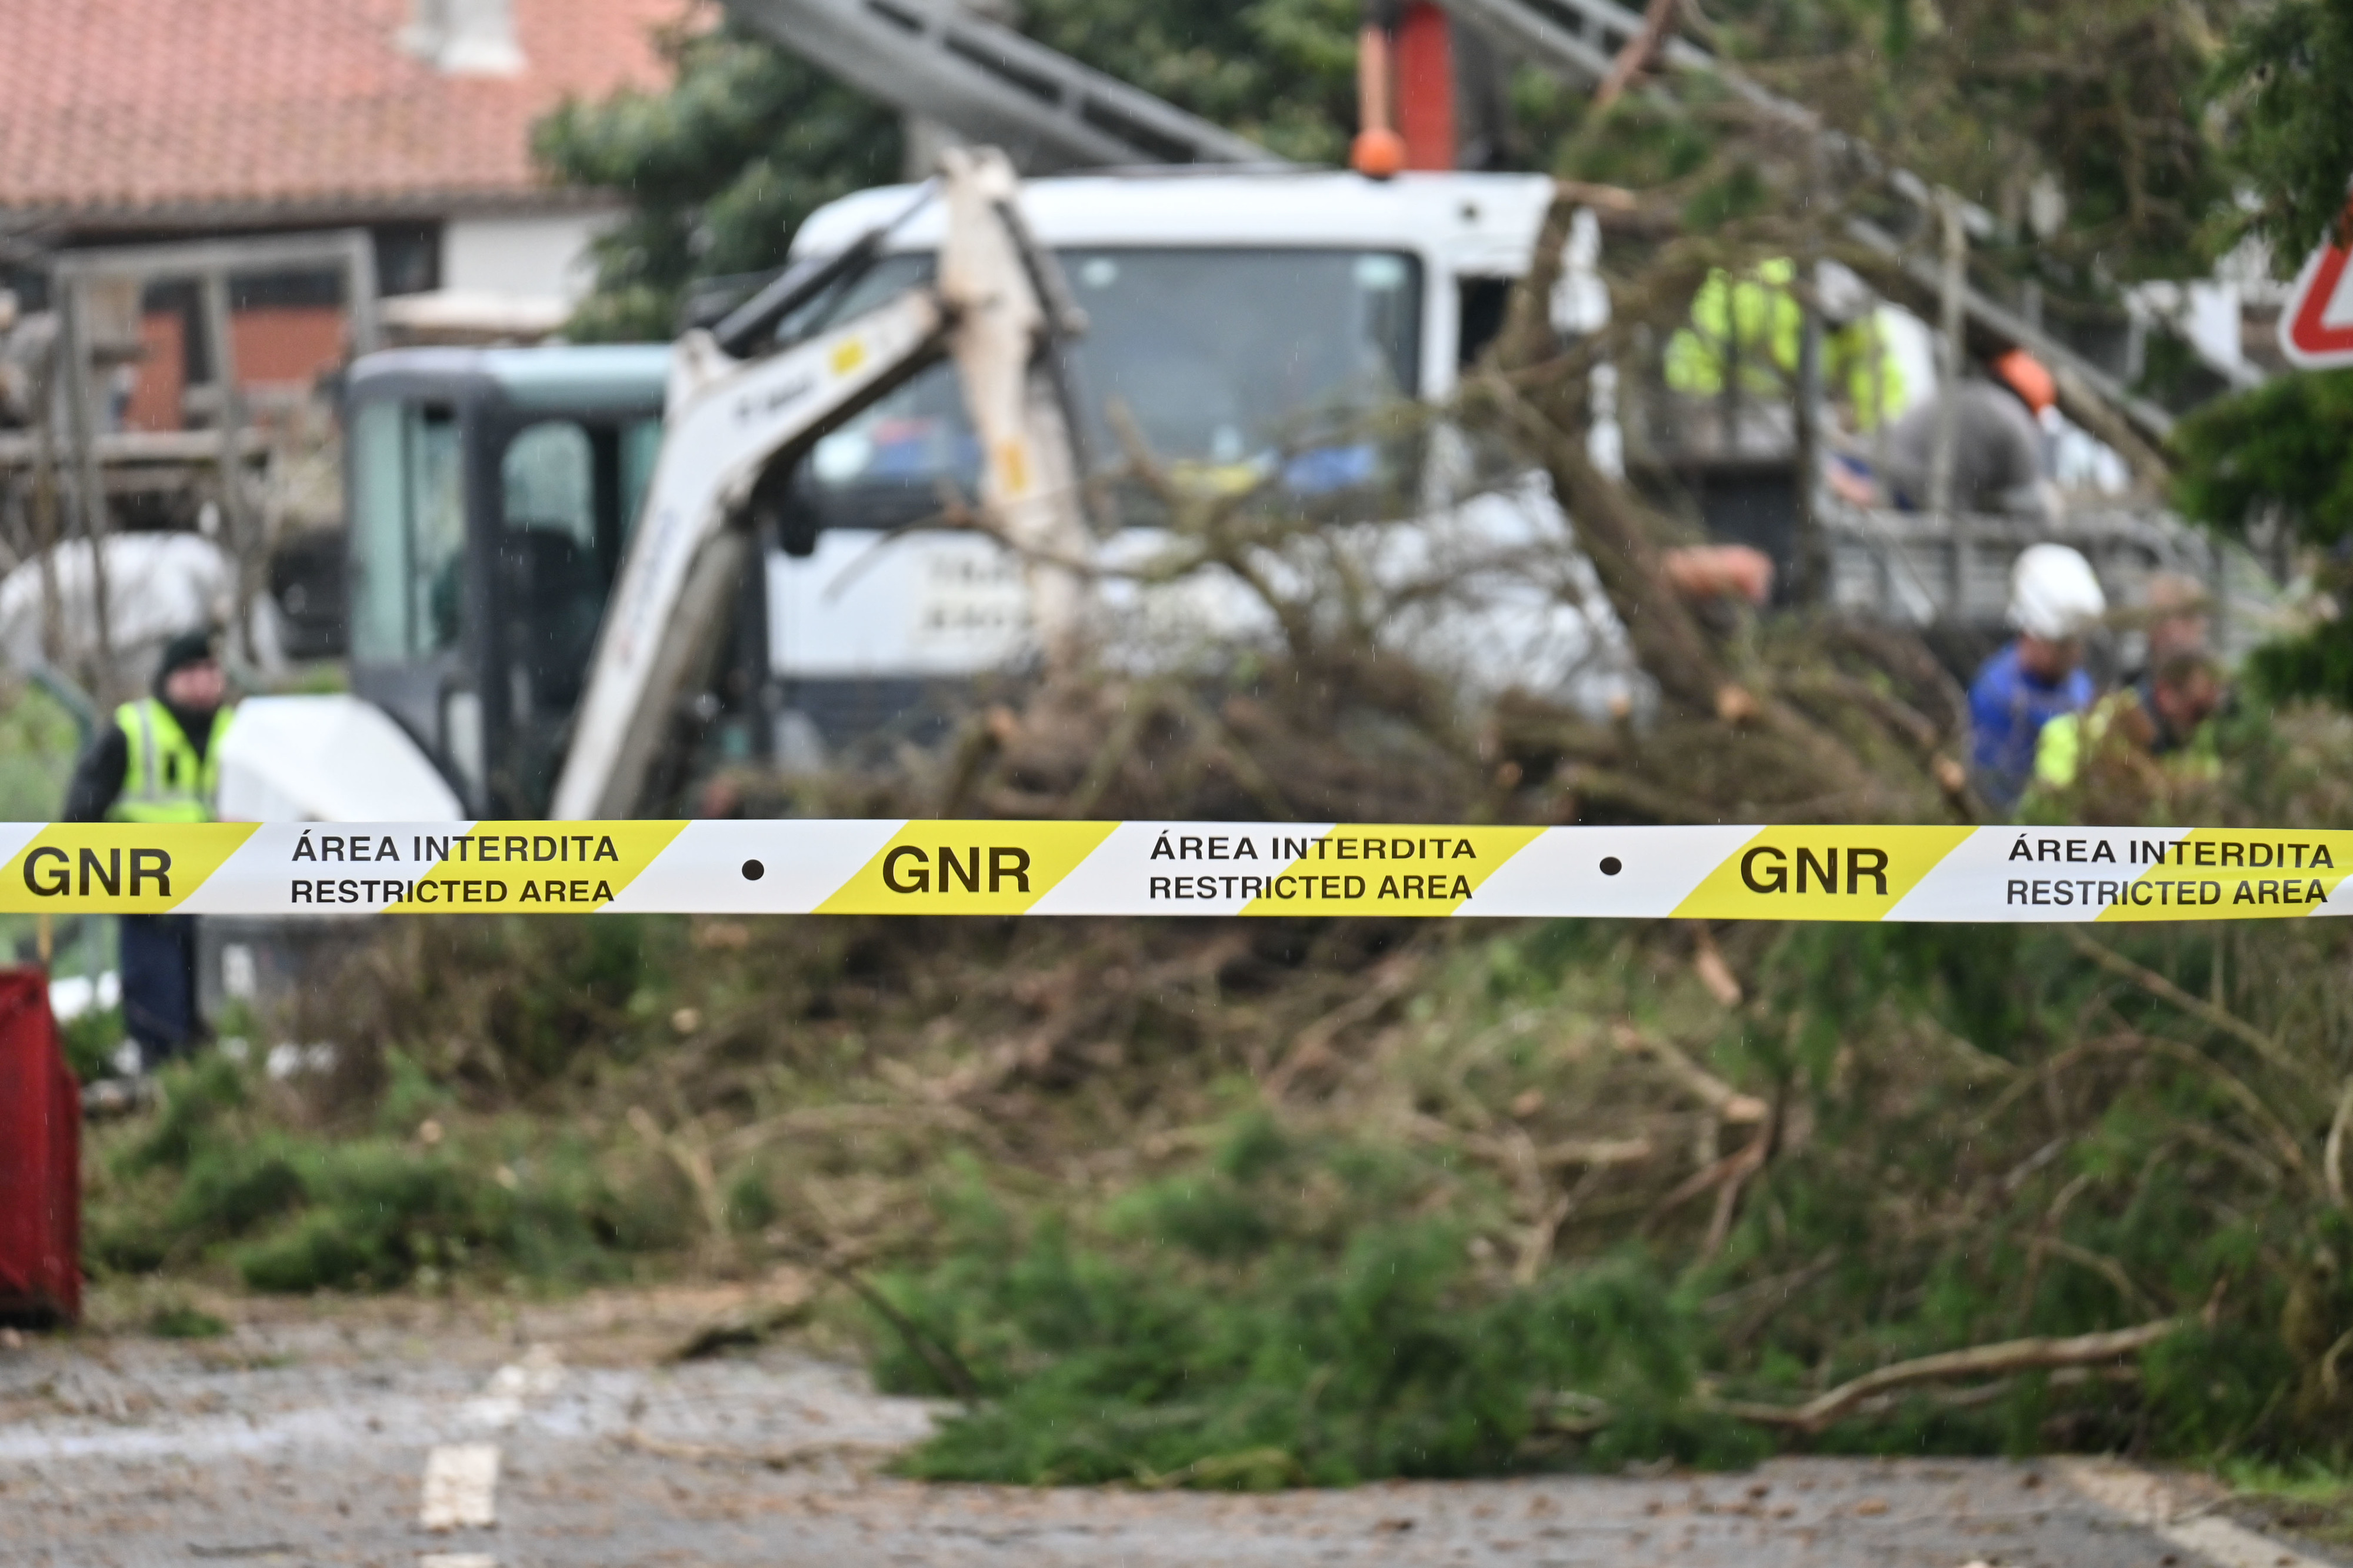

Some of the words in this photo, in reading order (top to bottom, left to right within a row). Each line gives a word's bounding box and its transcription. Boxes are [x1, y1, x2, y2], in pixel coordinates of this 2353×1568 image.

[291, 829, 401, 862] ÁREA
[414, 835, 619, 862] INTERDITA
[1149, 829, 1259, 860] ÁREA
[1272, 837, 1477, 860] INTERDITA
[2008, 833, 2117, 863] ÁREA
[2129, 839, 2335, 869] INTERDITA
[22, 846, 172, 898] GNR
[882, 845, 1031, 893] GNR
[1740, 846, 1889, 896] GNR
[291, 879, 508, 903] RESTRICTED
[518, 879, 615, 902] AREA
[1149, 875, 1366, 899] RESTRICTED
[1377, 875, 1473, 900] AREA
[2007, 879, 2221, 906] RESTRICTED
[2232, 879, 2329, 905] AREA
